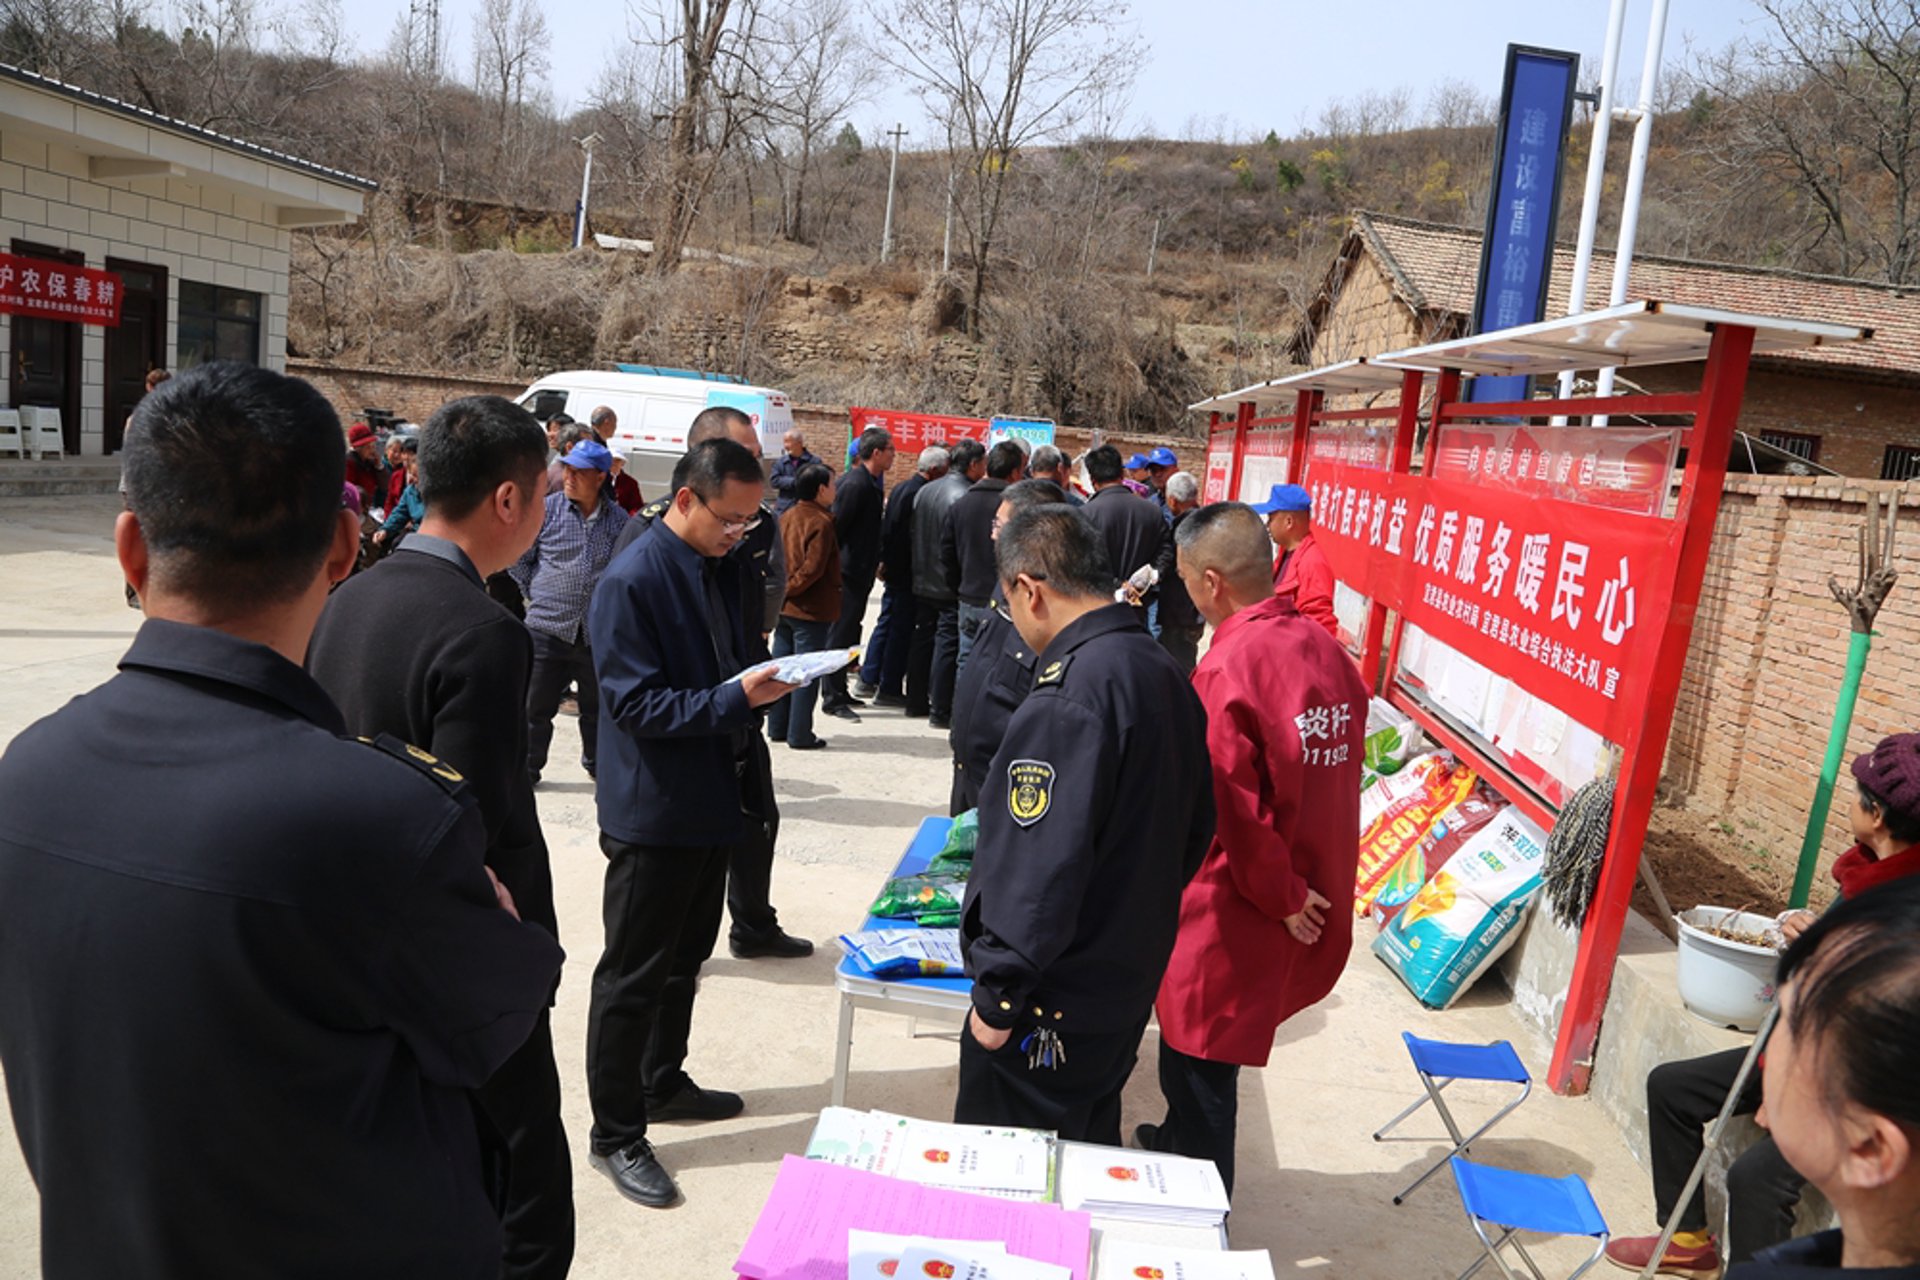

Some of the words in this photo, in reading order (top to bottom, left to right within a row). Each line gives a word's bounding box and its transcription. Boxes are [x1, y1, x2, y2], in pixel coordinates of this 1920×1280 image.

[1413, 503, 1636, 647] 优质服务暖民心
[1480, 610, 1601, 691] 宜君县农业综合执法大队
